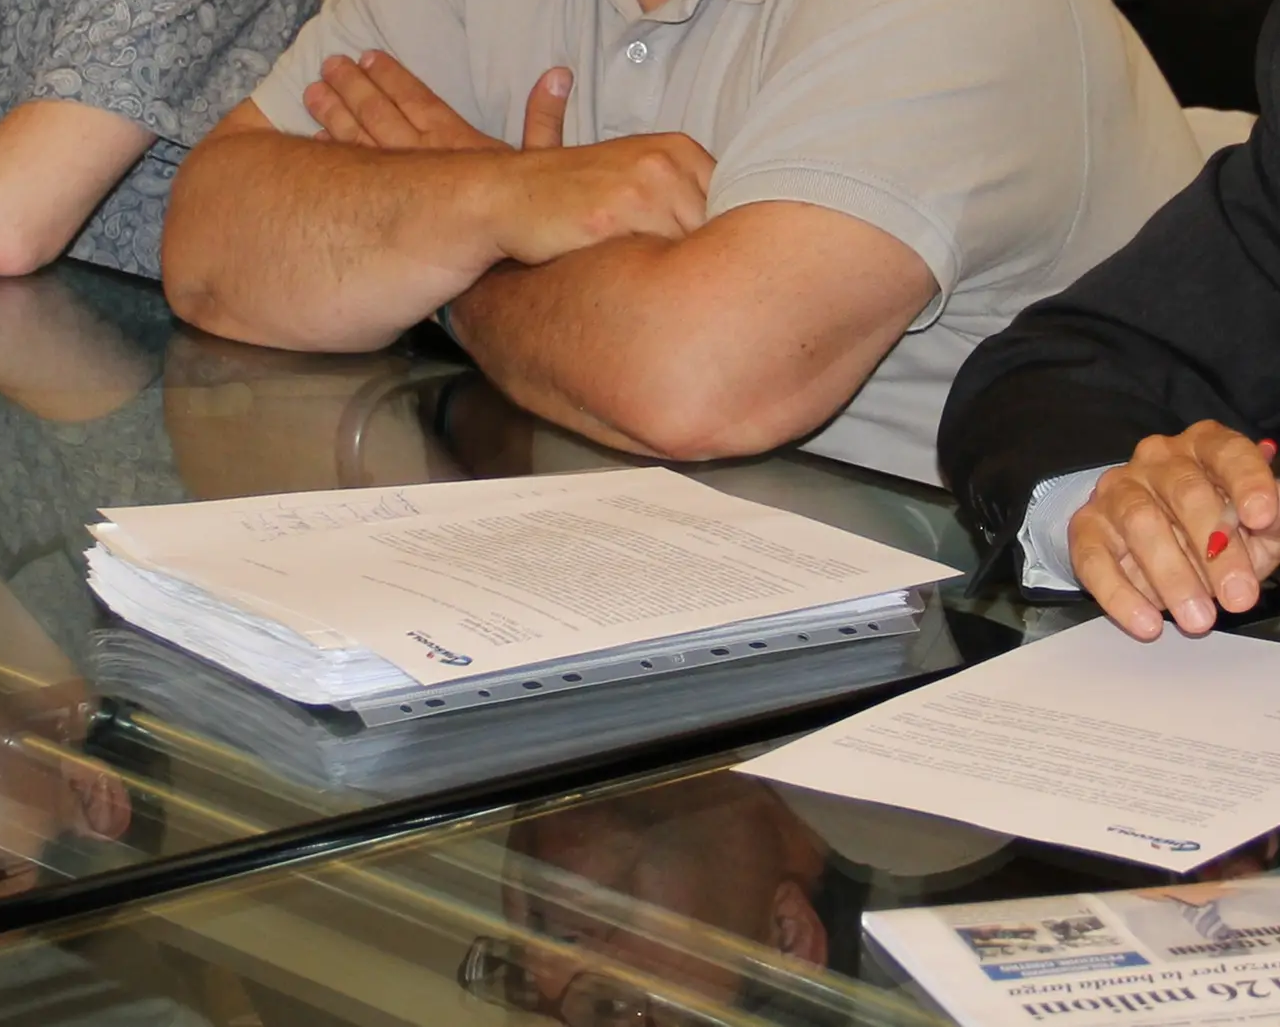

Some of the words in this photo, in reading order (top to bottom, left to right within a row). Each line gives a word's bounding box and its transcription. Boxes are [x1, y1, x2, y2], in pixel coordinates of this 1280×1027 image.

[1159, 971, 1183, 980] la
[1189, 962, 1227, 975] per
[1007, 982, 1072, 996] larga
[1078, 974, 1155, 991] banda
[1021, 987, 1195, 1020] milioni
